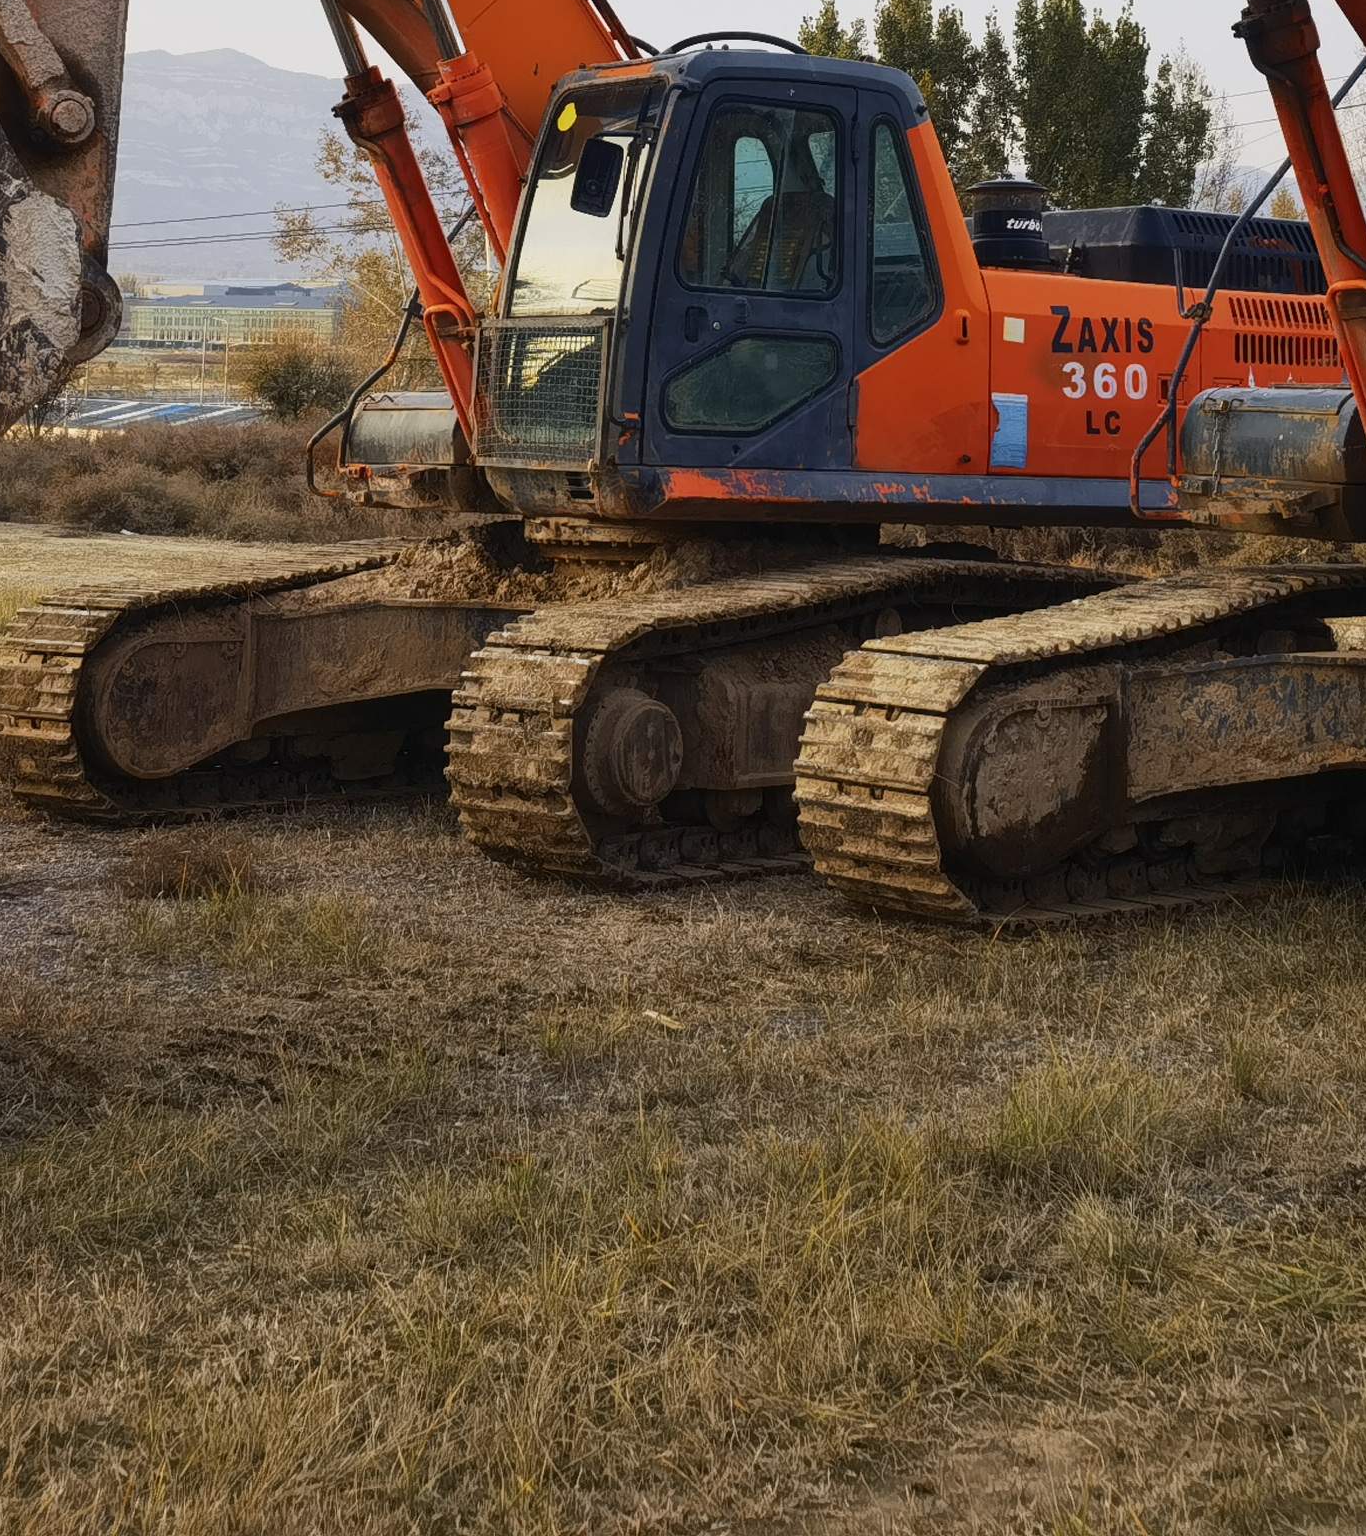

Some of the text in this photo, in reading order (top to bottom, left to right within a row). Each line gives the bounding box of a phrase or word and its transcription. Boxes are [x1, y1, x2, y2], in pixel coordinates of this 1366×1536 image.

[1050, 305, 1154, 353] ZAXIS
[1062, 361, 1148, 400] 360
[1086, 410, 1121, 435] LC
